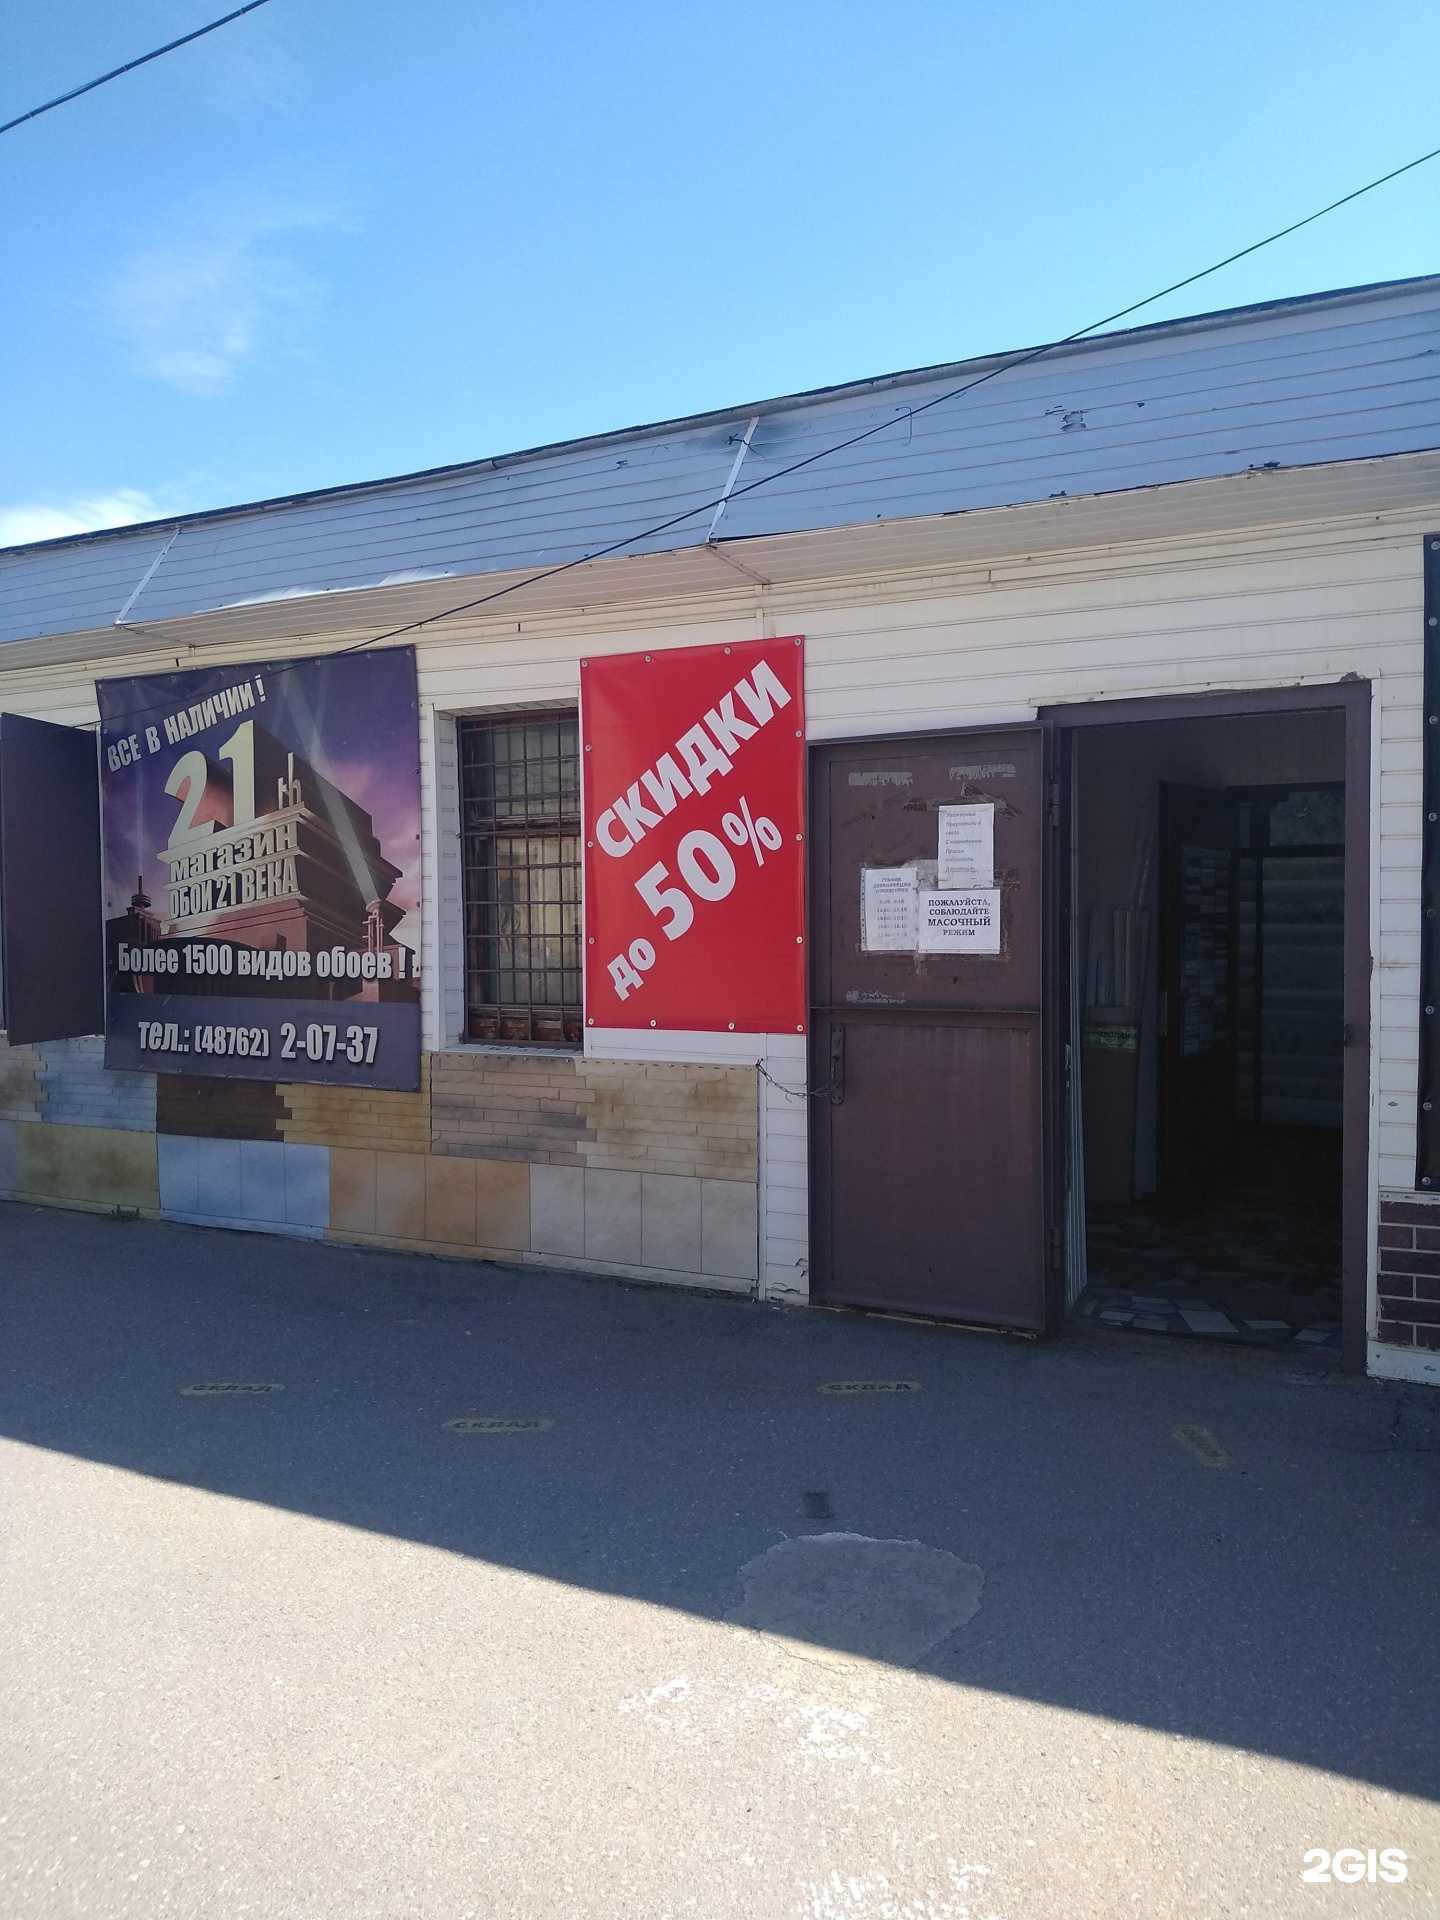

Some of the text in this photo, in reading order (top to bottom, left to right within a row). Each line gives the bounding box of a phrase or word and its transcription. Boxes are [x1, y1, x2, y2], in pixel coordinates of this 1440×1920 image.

[107, 734, 142, 772] ВСЕ
[145, 726, 161, 754] В
[163, 681, 255, 745] НАЛИЧИИ
[596, 659, 792, 858] СКИДКИ
[164, 719, 255, 849] 21
[169, 855, 300, 919] ОБОИ 21 ВЕКА
[634, 796, 783, 942] 50%
[928, 915, 991, 926] МАСОЧНЫЙ
[929, 907, 990, 916] СОБЛЮДАЙТЕ
[118, 943, 179, 974] Более
[182, 944, 233, 975] 1500
[237, 950, 312, 981] видов
[316, 945, 392, 979] обоев
[138, 1021, 378, 1063] тел.: (48762) 2-07-37
